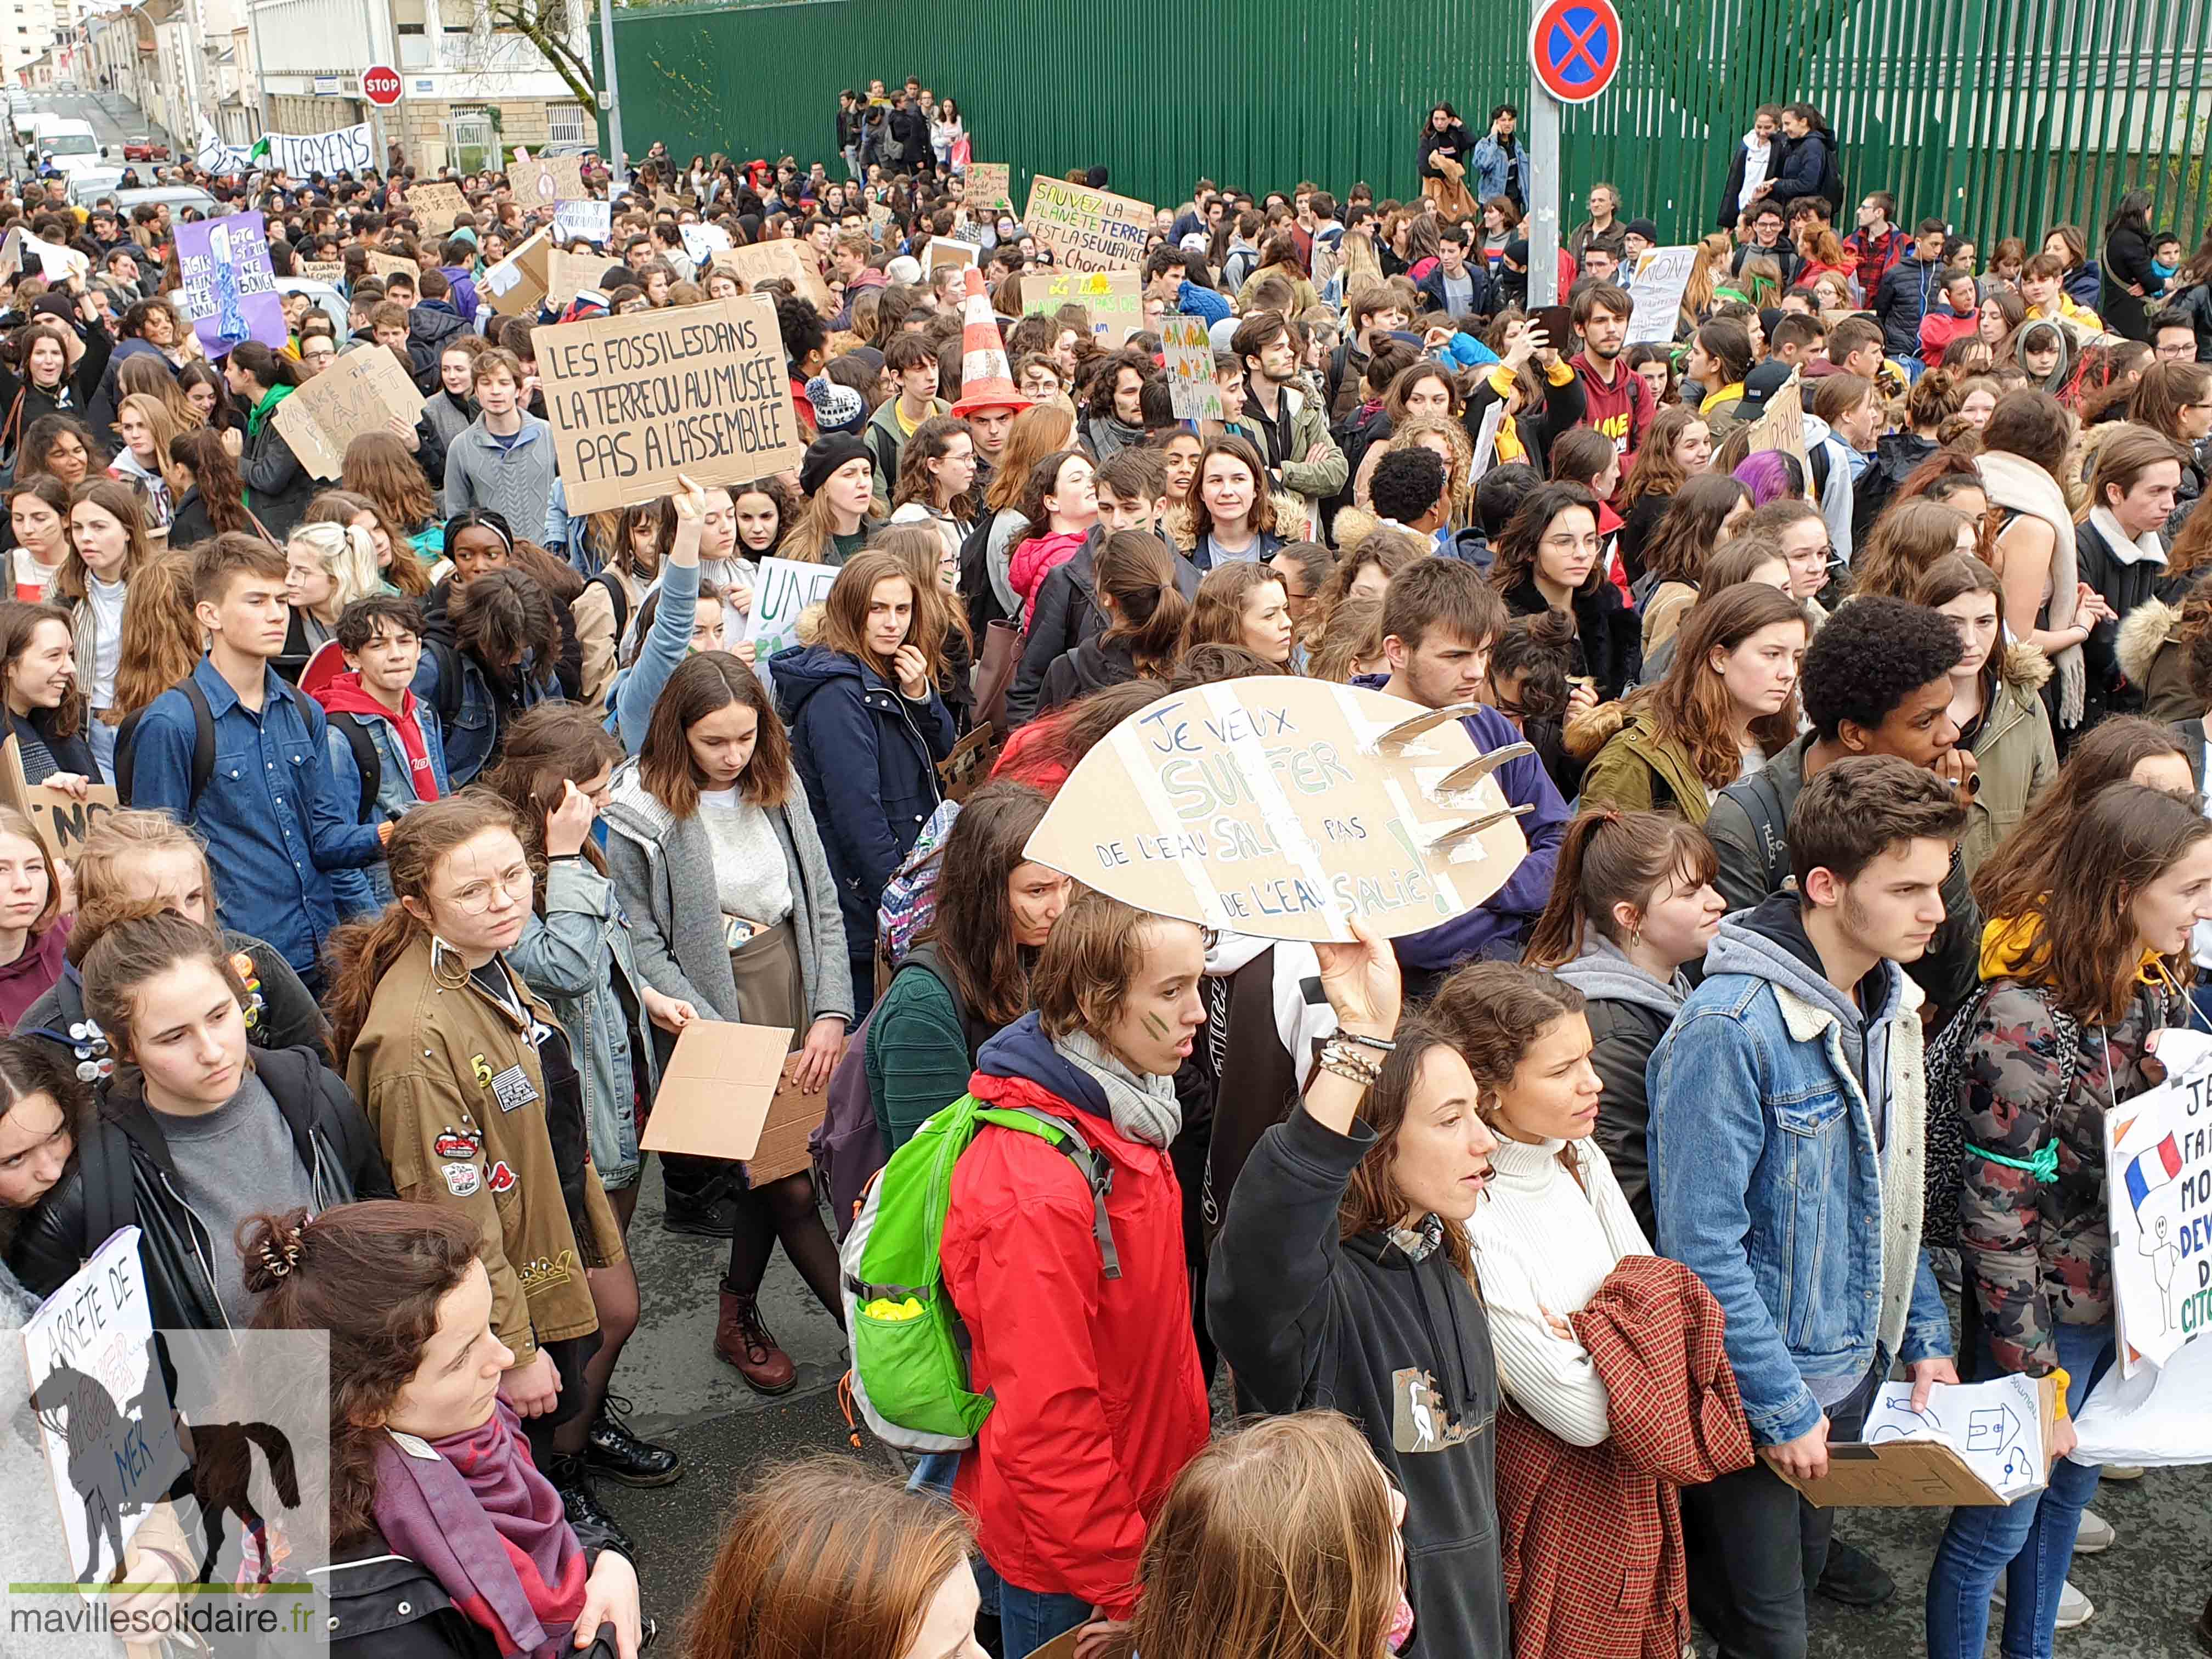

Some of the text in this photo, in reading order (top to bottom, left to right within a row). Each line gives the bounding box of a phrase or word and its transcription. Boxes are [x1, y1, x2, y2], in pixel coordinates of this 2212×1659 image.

[366, 79, 398, 92] STOP
[1035, 183, 1123, 218] SAUVEZ LA
[1027, 220, 1061, 240] C'EST
[1062, 228, 1079, 245] LA
[1101, 219, 1148, 245] TERRE
[183, 254, 260, 274] AGIR NE
[1641, 254, 1685, 282] NON
[1094, 296, 1116, 312] PAS
[1120, 295, 1138, 312] DE
[549, 343, 599, 379] LES
[281, 381, 340, 433] MAKE
[556, 391, 589, 430] LA
[685, 369, 711, 409] AU
[714, 351, 783, 406] MUSÉE
[576, 402, 787, 482] PAS A L'ASSEMBLÉE
[1204, 708, 1296, 743] VEUX
[1096, 843, 1130, 868] DE
[1136, 832, 1207, 860] L'EAU
[1323, 816, 1367, 840] PAS
[1220, 892, 1250, 918] DE
[1251, 878, 1327, 916] L'EAU
[470, 1053, 493, 1089] 5
[109, 1255, 134, 1311] DE
[84, 1417, 155, 1539] TA MER
